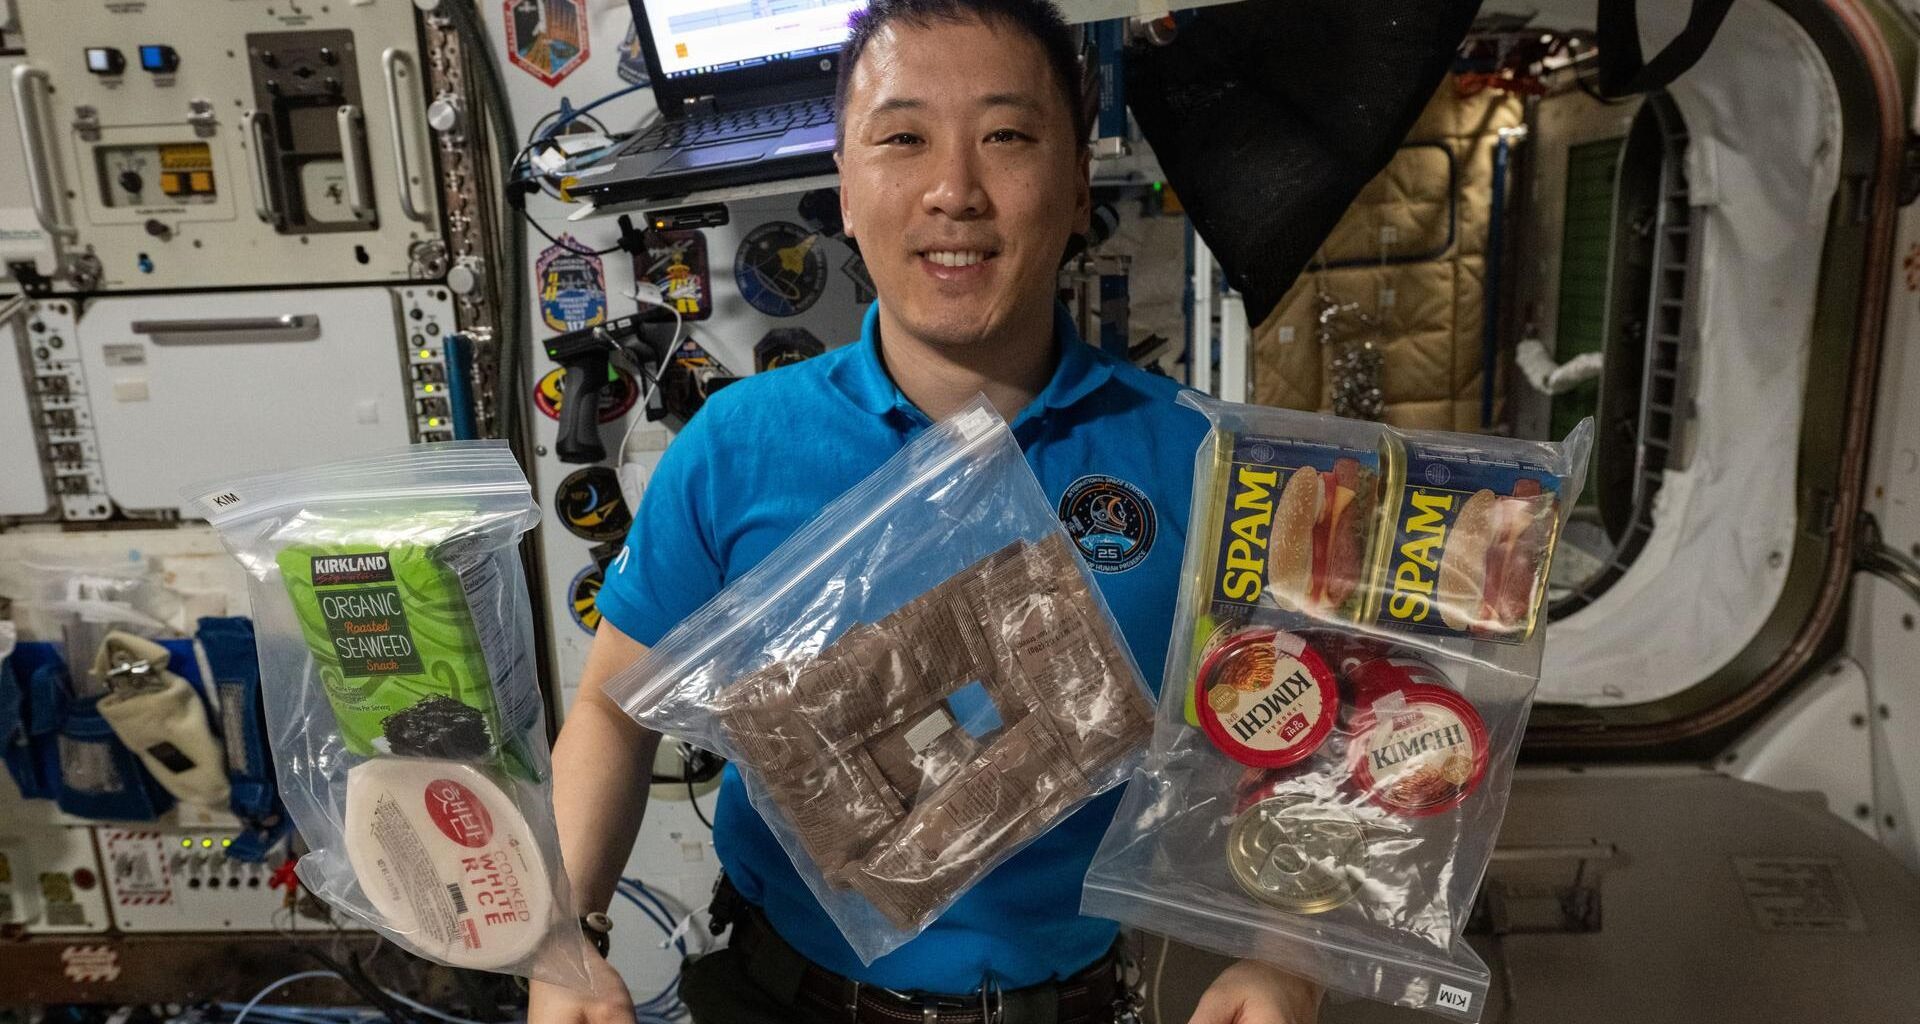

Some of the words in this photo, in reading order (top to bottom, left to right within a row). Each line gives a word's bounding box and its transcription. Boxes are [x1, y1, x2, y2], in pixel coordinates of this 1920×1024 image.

[567, 320, 585, 331] 117
[213, 493, 240, 507] KIM
[1105, 478, 1124, 487] SPACE
[1124, 482, 1147, 500] STATION
[1223, 467, 1277, 602] SPAM
[315, 556, 387, 574] KIRKLAND
[1098, 549, 1117, 559] 25
[1389, 491, 1453, 622] SPAM
[322, 592, 401, 619] ORGANIC
[344, 619, 390, 634] Roasted
[336, 635, 411, 658] SEAWEED
[367, 659, 399, 671] Snack
[1232, 670, 1312, 741] KIMCHI
[1285, 720, 1304, 738] 양반
[1371, 723, 1464, 769] KIMCHI
[432, 785, 485, 840] 햇반
[461, 857, 503, 926] RICE
[479, 853, 518, 923] WHITE
[494, 850, 531, 922] COOKED
[1440, 990, 1467, 1007] KIM
